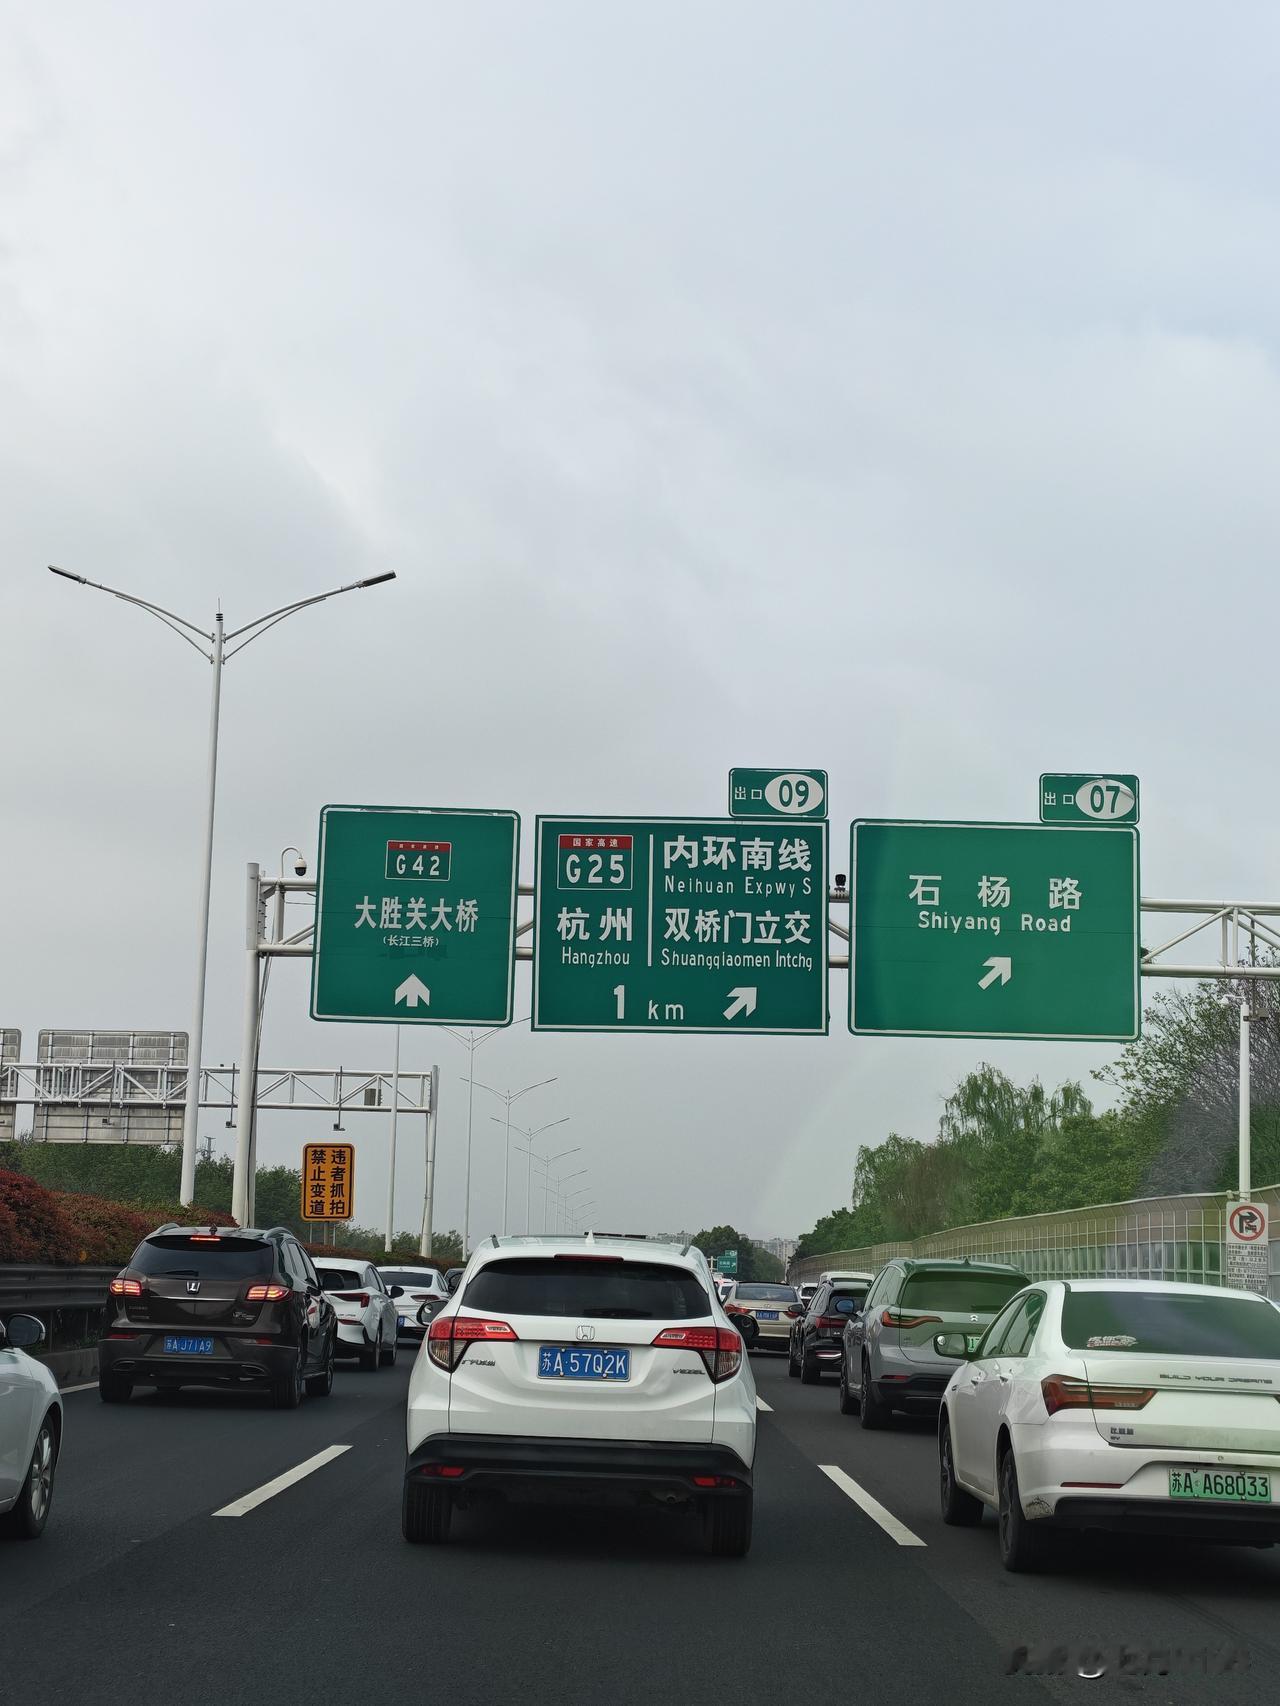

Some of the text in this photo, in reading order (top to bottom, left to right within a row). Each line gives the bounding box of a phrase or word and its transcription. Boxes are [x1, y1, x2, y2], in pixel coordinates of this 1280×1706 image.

[734, 779, 810, 807] 出口 09
[1044, 785, 1120, 814] 出口 07
[572, 837, 618, 848] 国家高速
[663, 834, 812, 872] 内环南线
[396, 854, 440, 876] G42
[566, 854, 625, 884] G25
[664, 875, 812, 898] Neihuan Expwy S
[908, 874, 1083, 910] 石杨路
[355, 895, 479, 933] 大胜关大桥
[556, 906, 633, 942] 杭州
[663, 908, 811, 944] 双桥门立交
[918, 910, 1072, 936] Shiyang Road
[561, 946, 630, 968] Hangzhou
[661, 949, 812, 971] Shuangqiaomen Intchg
[613, 984, 684, 1020] 1 km
[310, 1148, 327, 1215] 禁止变道
[329, 1149, 347, 1215] 违者抓拍
